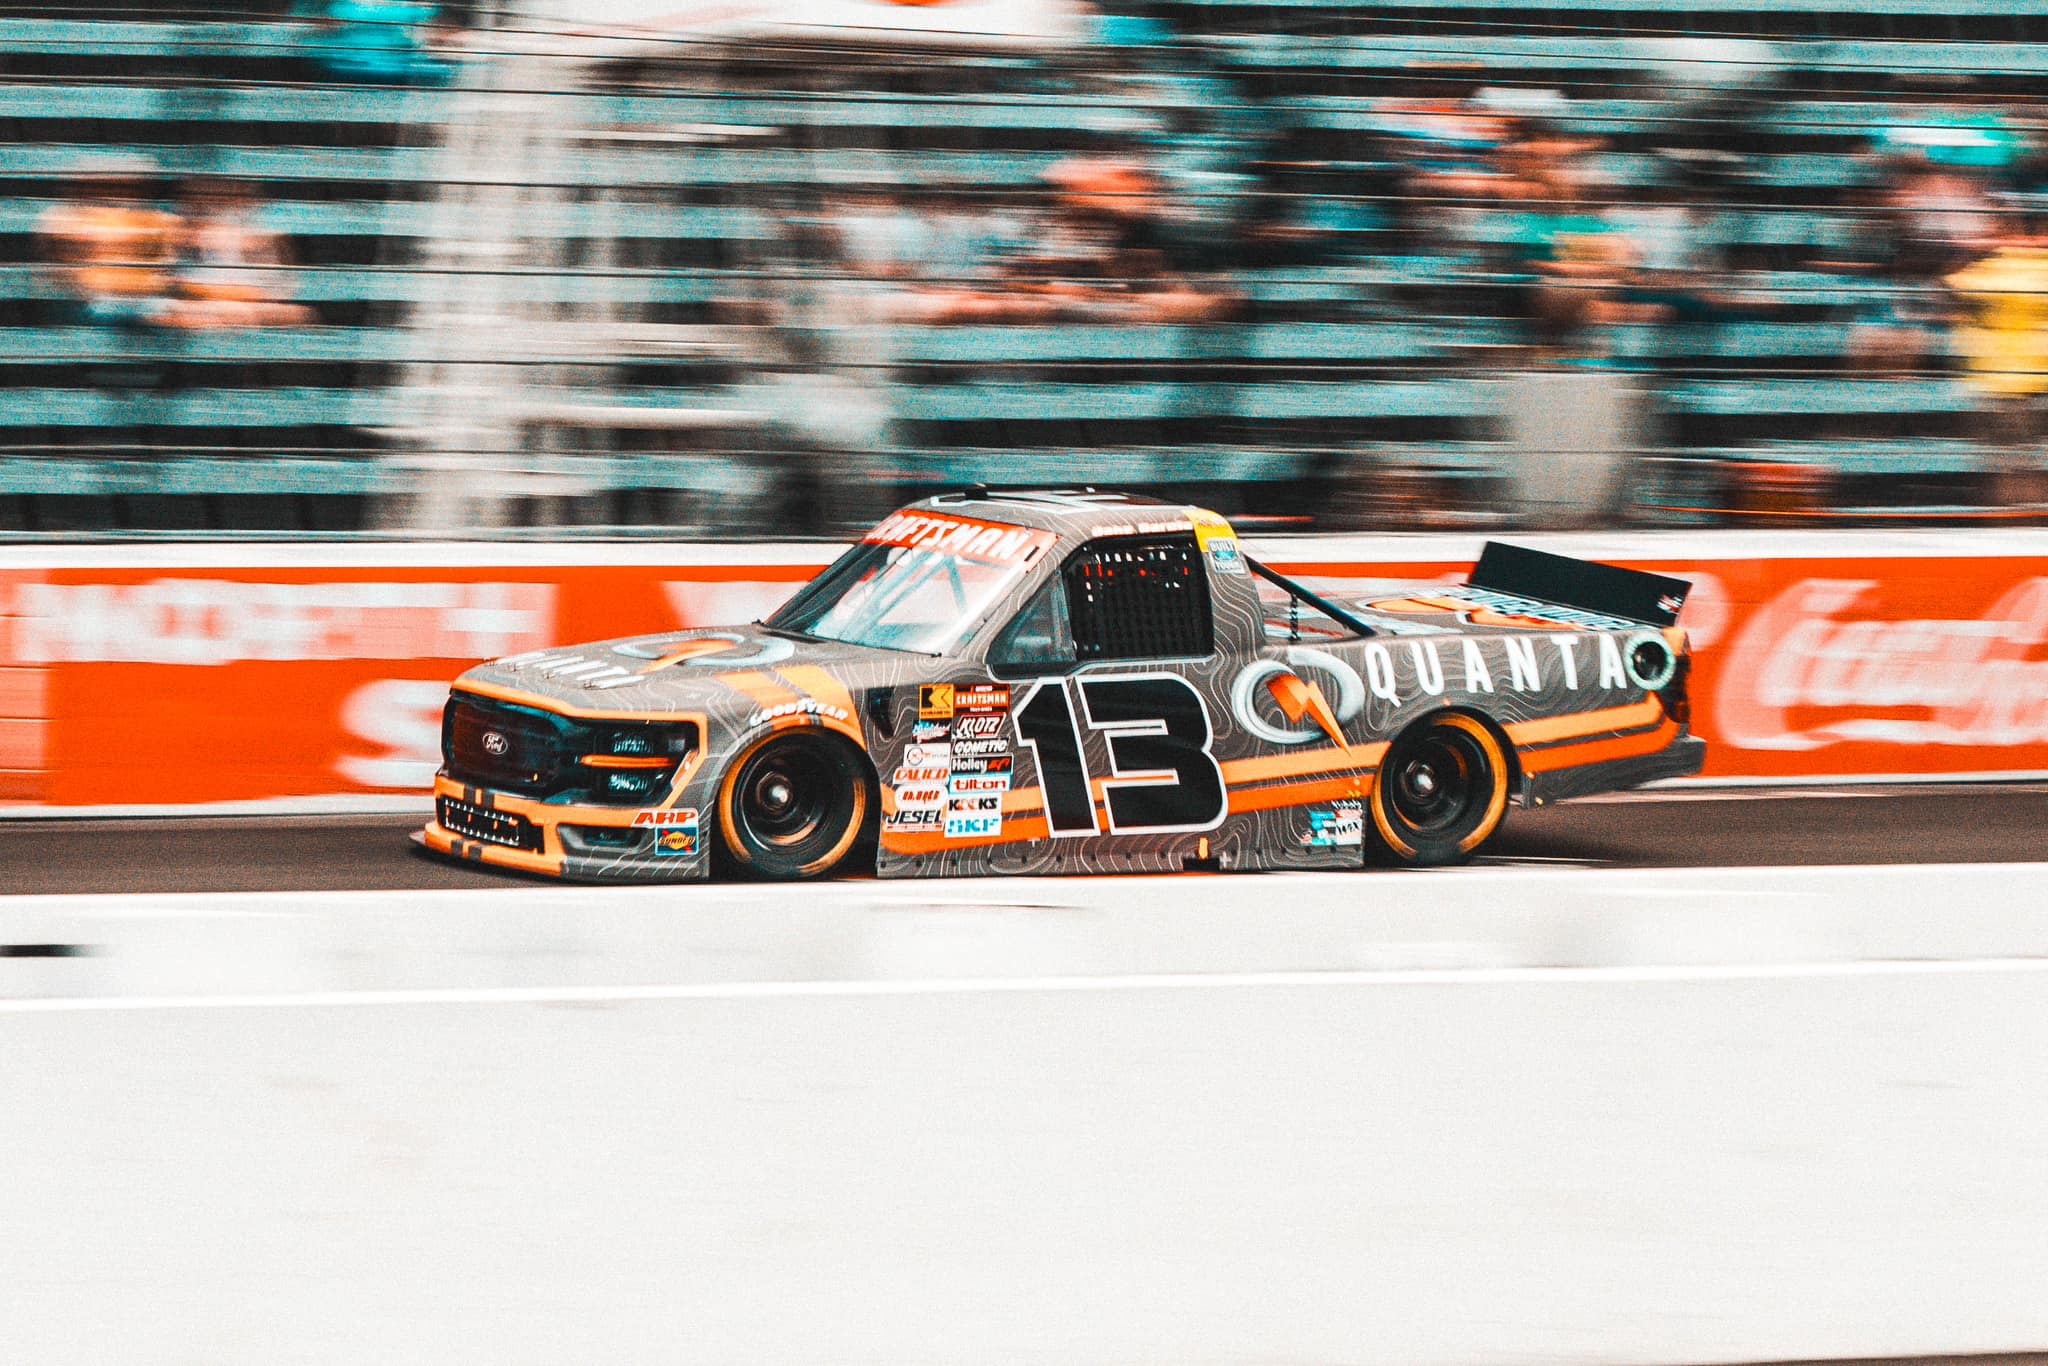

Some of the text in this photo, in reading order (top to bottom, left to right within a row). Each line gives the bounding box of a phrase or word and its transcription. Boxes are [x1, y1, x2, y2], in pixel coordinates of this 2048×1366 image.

[1365, 632, 1628, 708] QUANTA
[956, 693, 1008, 705] CRAFTSMAN
[750, 698, 849, 728] GOODYEAR
[958, 716, 1001, 733] KLOTZ
[1012, 671, 1229, 838] 13
[895, 767, 949, 780] CALICO
[952, 757, 988, 774] Holley
[634, 811, 697, 825] ARP
[887, 809, 942, 825] JESEL
[947, 818, 1000, 834] SKF
[658, 835, 696, 846] SUNOCO
